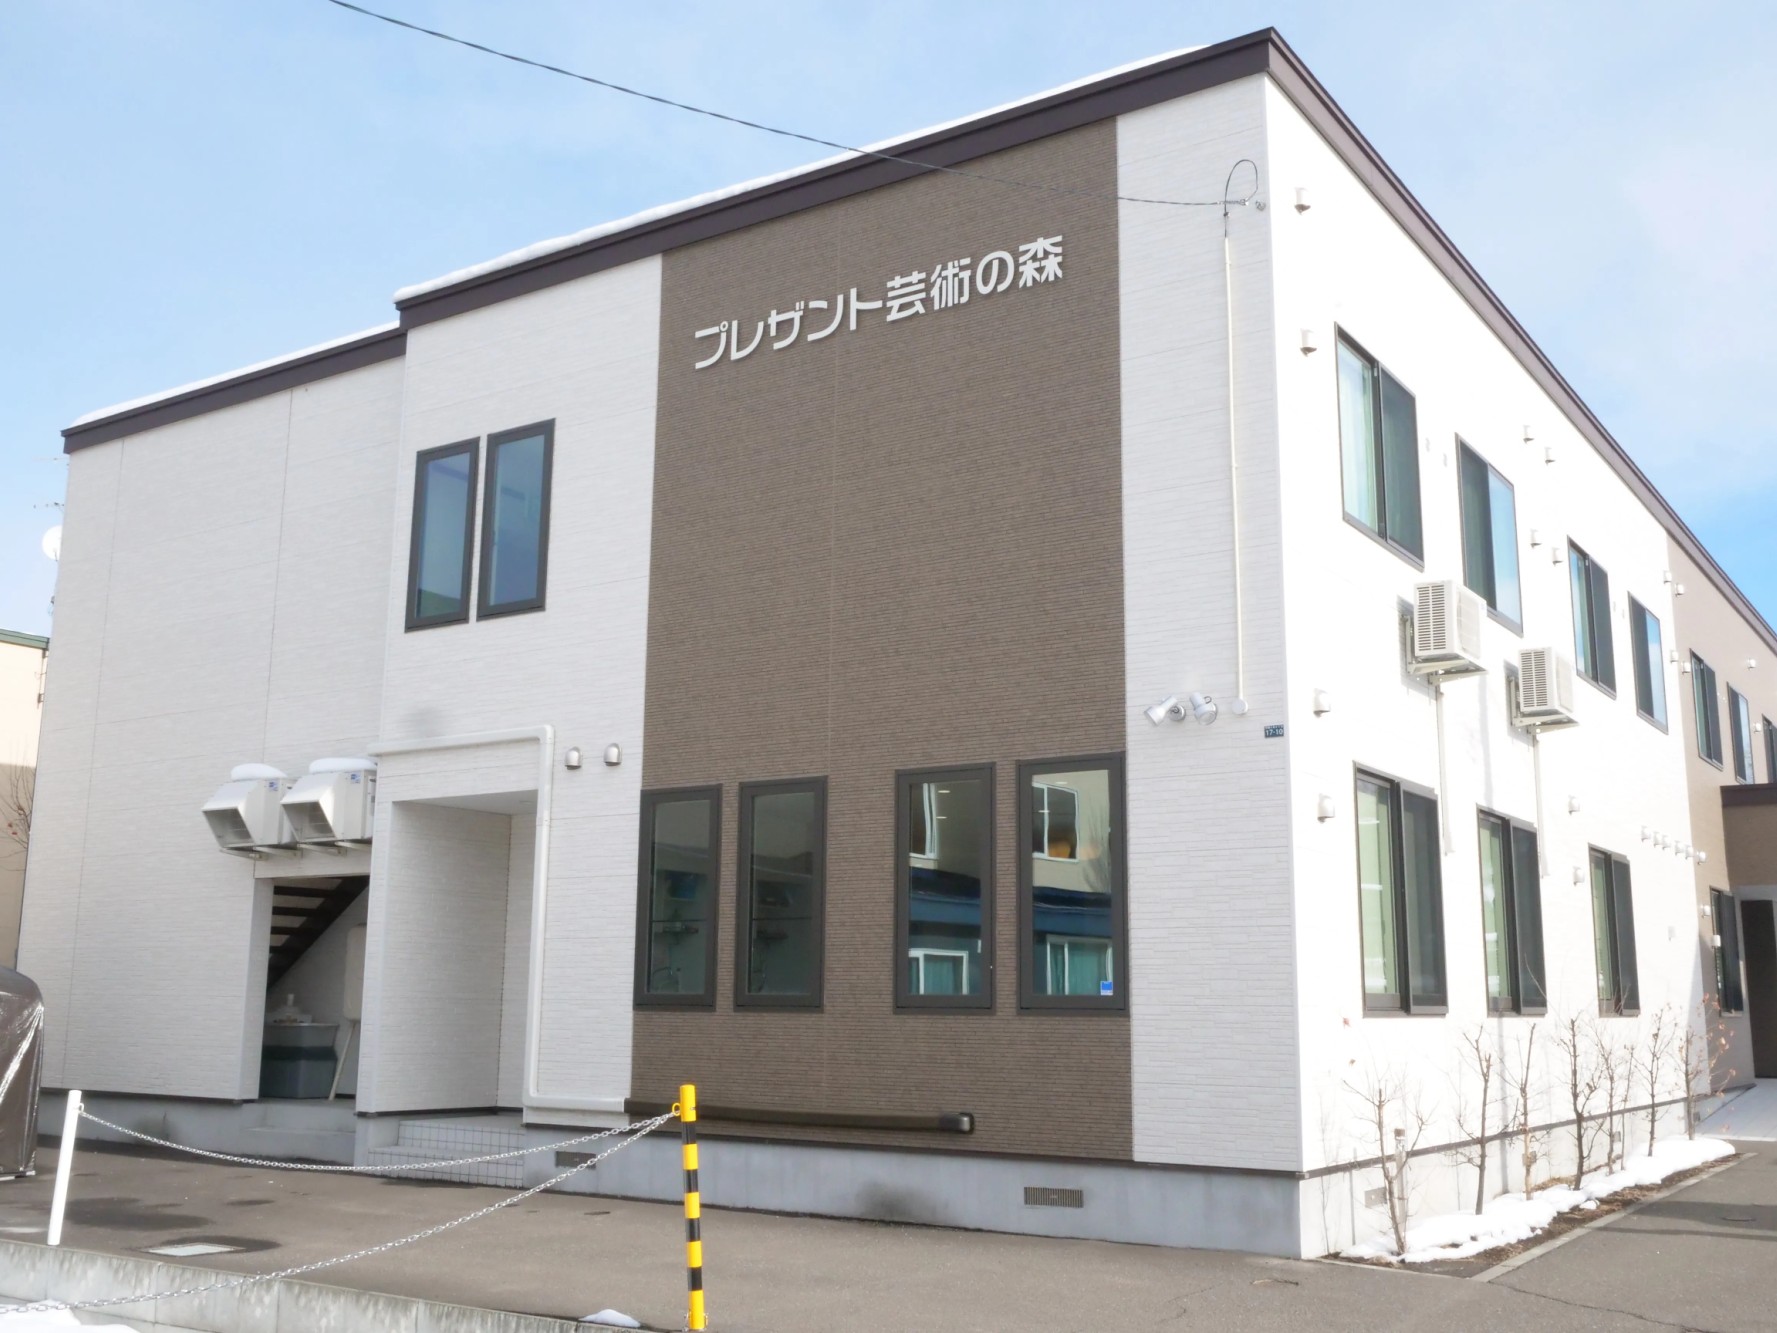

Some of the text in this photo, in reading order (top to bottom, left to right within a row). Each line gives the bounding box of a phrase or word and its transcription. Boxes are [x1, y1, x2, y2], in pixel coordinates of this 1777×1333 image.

[695, 235, 1063, 370] プレザント芸術の森
